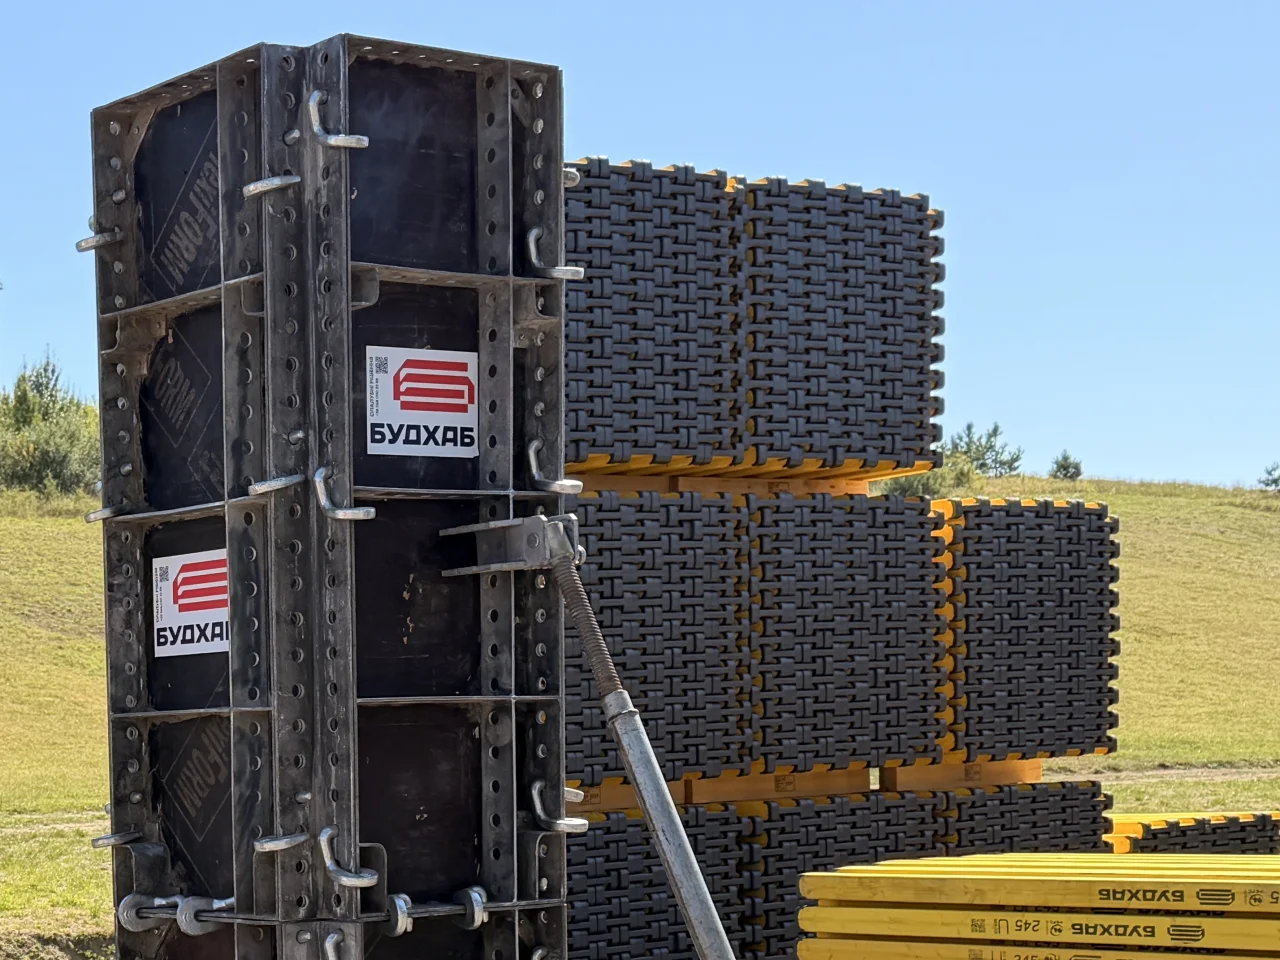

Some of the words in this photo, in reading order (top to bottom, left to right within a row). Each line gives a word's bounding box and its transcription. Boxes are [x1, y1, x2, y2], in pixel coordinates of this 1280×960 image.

[160, 151, 217, 286] exiFORM
[370, 422, 475, 448] БУДХАБ
[1098, 888, 1185, 902] БУДХАБ
[1015, 919, 1040, 932] 245
[1071, 922, 1156, 938] БУДХАБ
